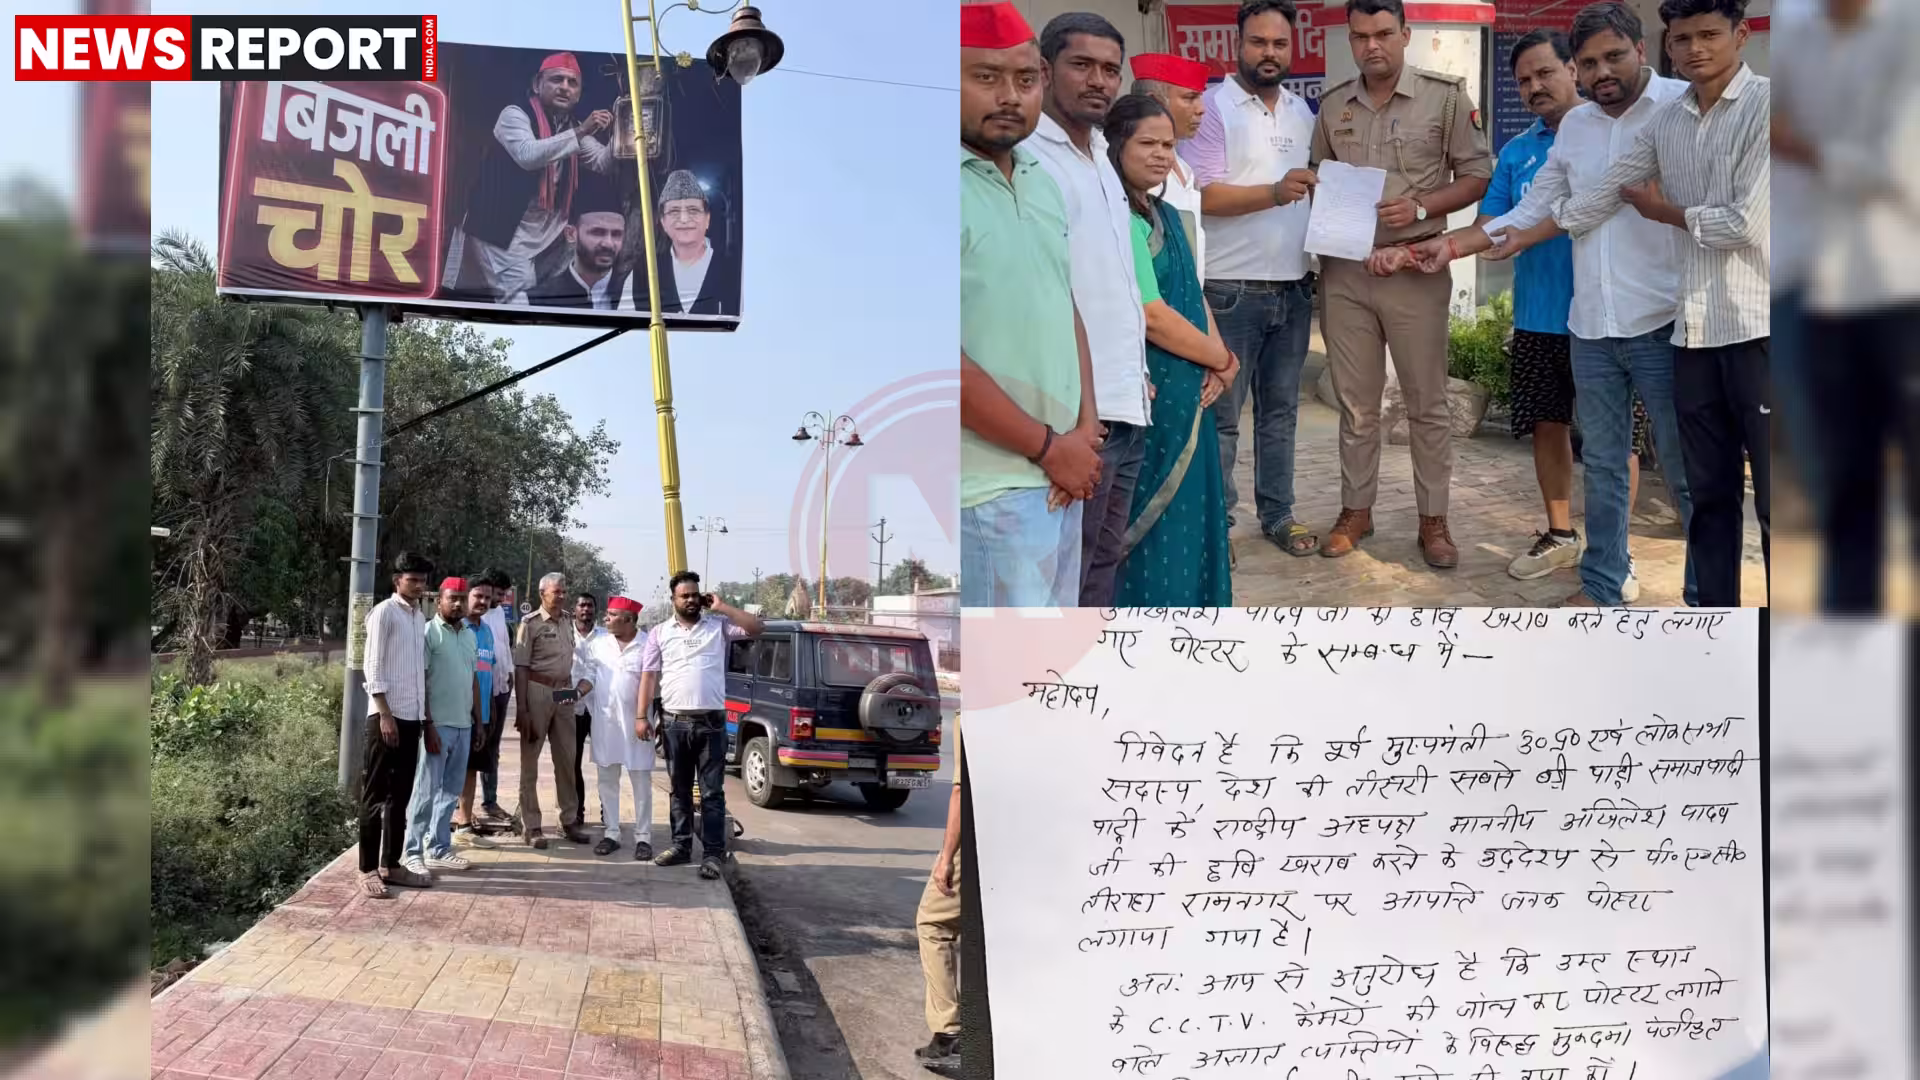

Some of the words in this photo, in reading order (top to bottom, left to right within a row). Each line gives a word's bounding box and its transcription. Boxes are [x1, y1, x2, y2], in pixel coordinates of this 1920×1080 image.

[253, 158, 427, 283] चोर
[1096, 630, 1144, 669] गए
[1170, 626, 1248, 674] पोस्टर
[1280, 632, 1309, 665] के
[1437, 630, 1460, 669] में
[1214, 731, 1241, 766] है
[1269, 734, 1305, 765] कि
[1324, 725, 1373, 763] पूर्व
[1215, 771, 1278, 802] देश
[1295, 774, 1334, 799] की
[1345, 764, 1440, 802] तीसरी
[1448, 759, 1522, 796] सबसे
[1164, 810, 1197, 839] के
[1680, 802, 1740, 825] यादव
[1088, 846, 1132, 877] जी
[1148, 852, 1188, 878] की
[1440, 843, 1463, 869] के
[1589, 838, 1636, 873] से
[1181, 890, 1307, 922] रामनगर
[1313, 893, 1358, 917] पर
[1204, 928, 1262, 949] गया
[1197, 972, 1265, 995] आप
[1273, 962, 1310, 994] से
[1454, 950, 1485, 982] है
[1499, 947, 1542, 977] कि
[1108, 1006, 1130, 1035] के
[1405, 995, 1441, 1022] की
[1582, 981, 1662, 1006] पोस्टर
[1442, 1030, 1459, 1055] के
